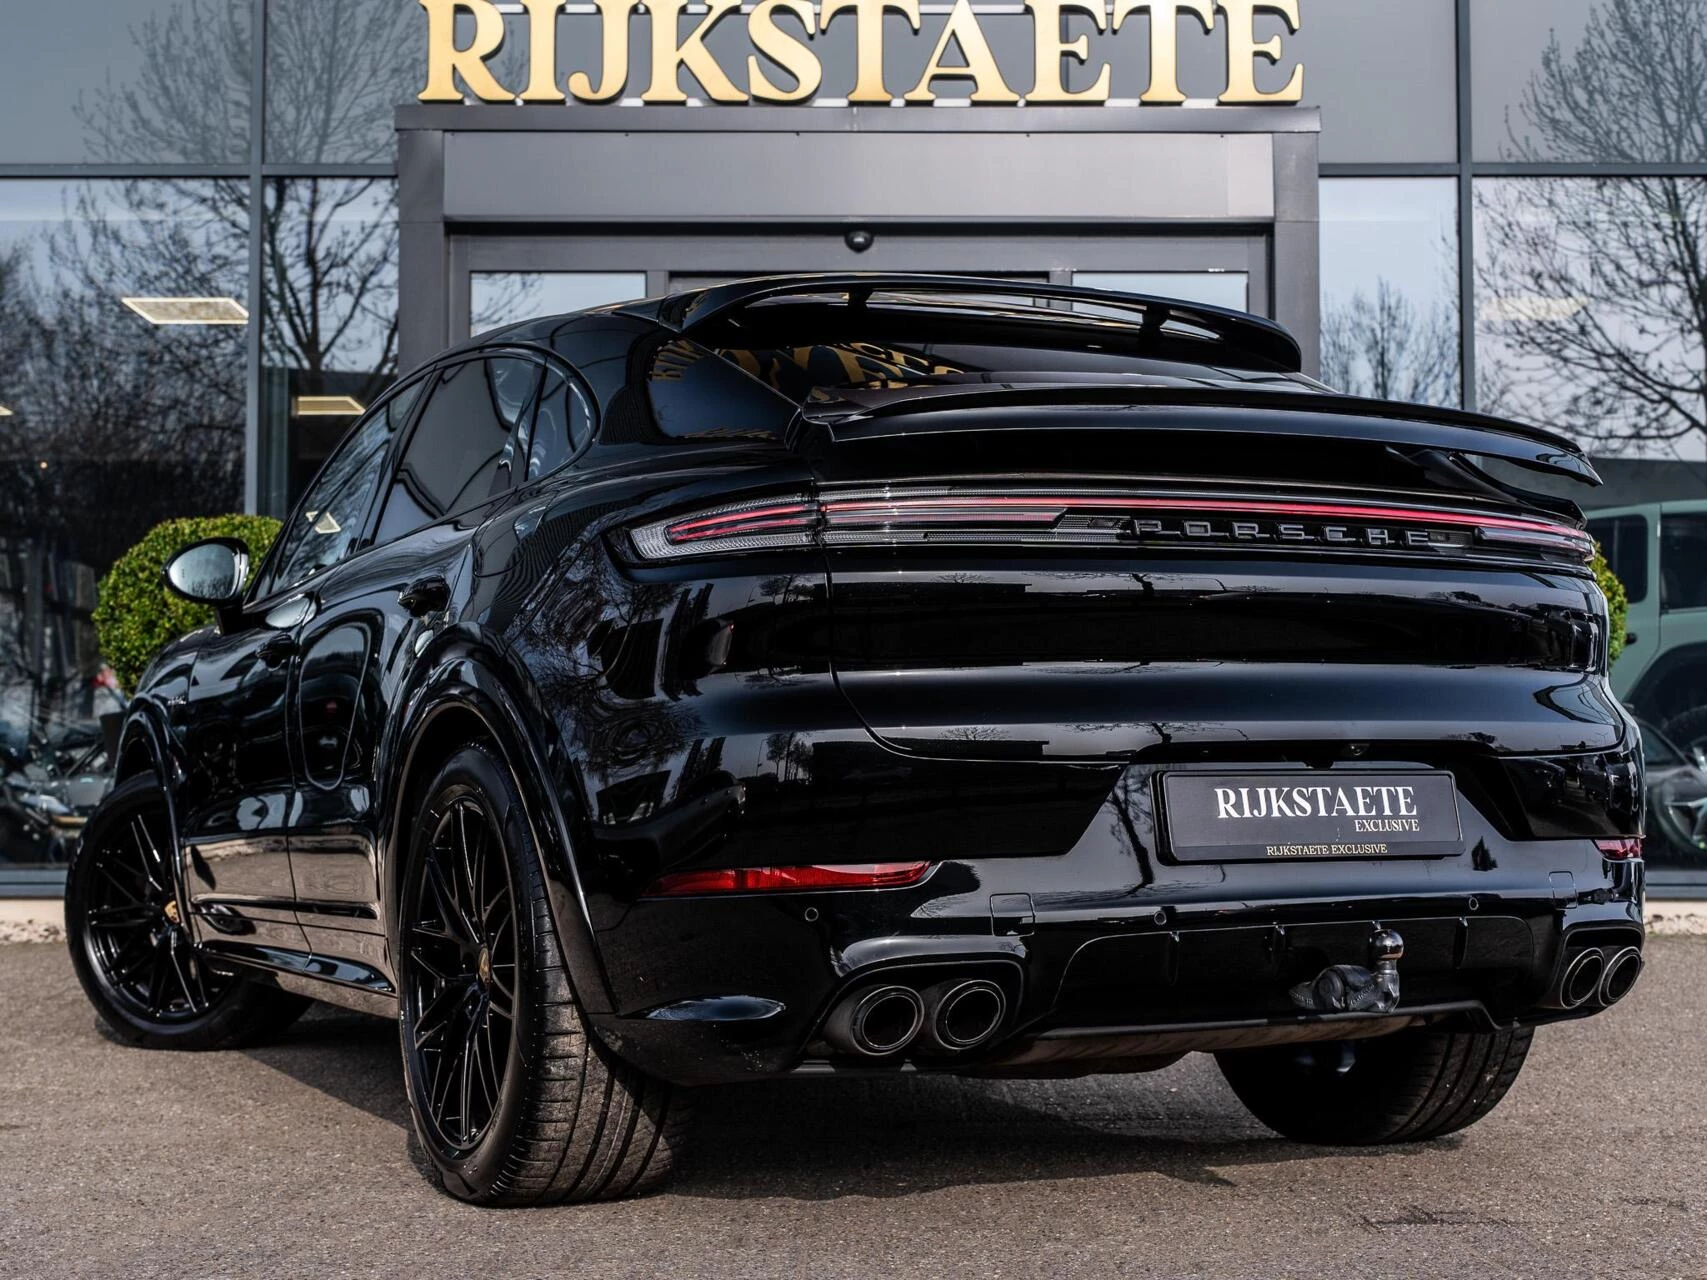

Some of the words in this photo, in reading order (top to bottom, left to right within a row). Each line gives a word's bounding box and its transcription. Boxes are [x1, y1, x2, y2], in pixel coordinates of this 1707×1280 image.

[417, 0, 1303, 105] RIJKSTAETE
[1133, 519, 1429, 546] PORSCHE
[1214, 786, 1417, 819] RIJKSTAETE
[1354, 818, 1420, 833] EXCLUSIVE
[1266, 844, 1329, 856] RIJKSTAETE
[1331, 843, 1388, 855] EXCLUSIVE
